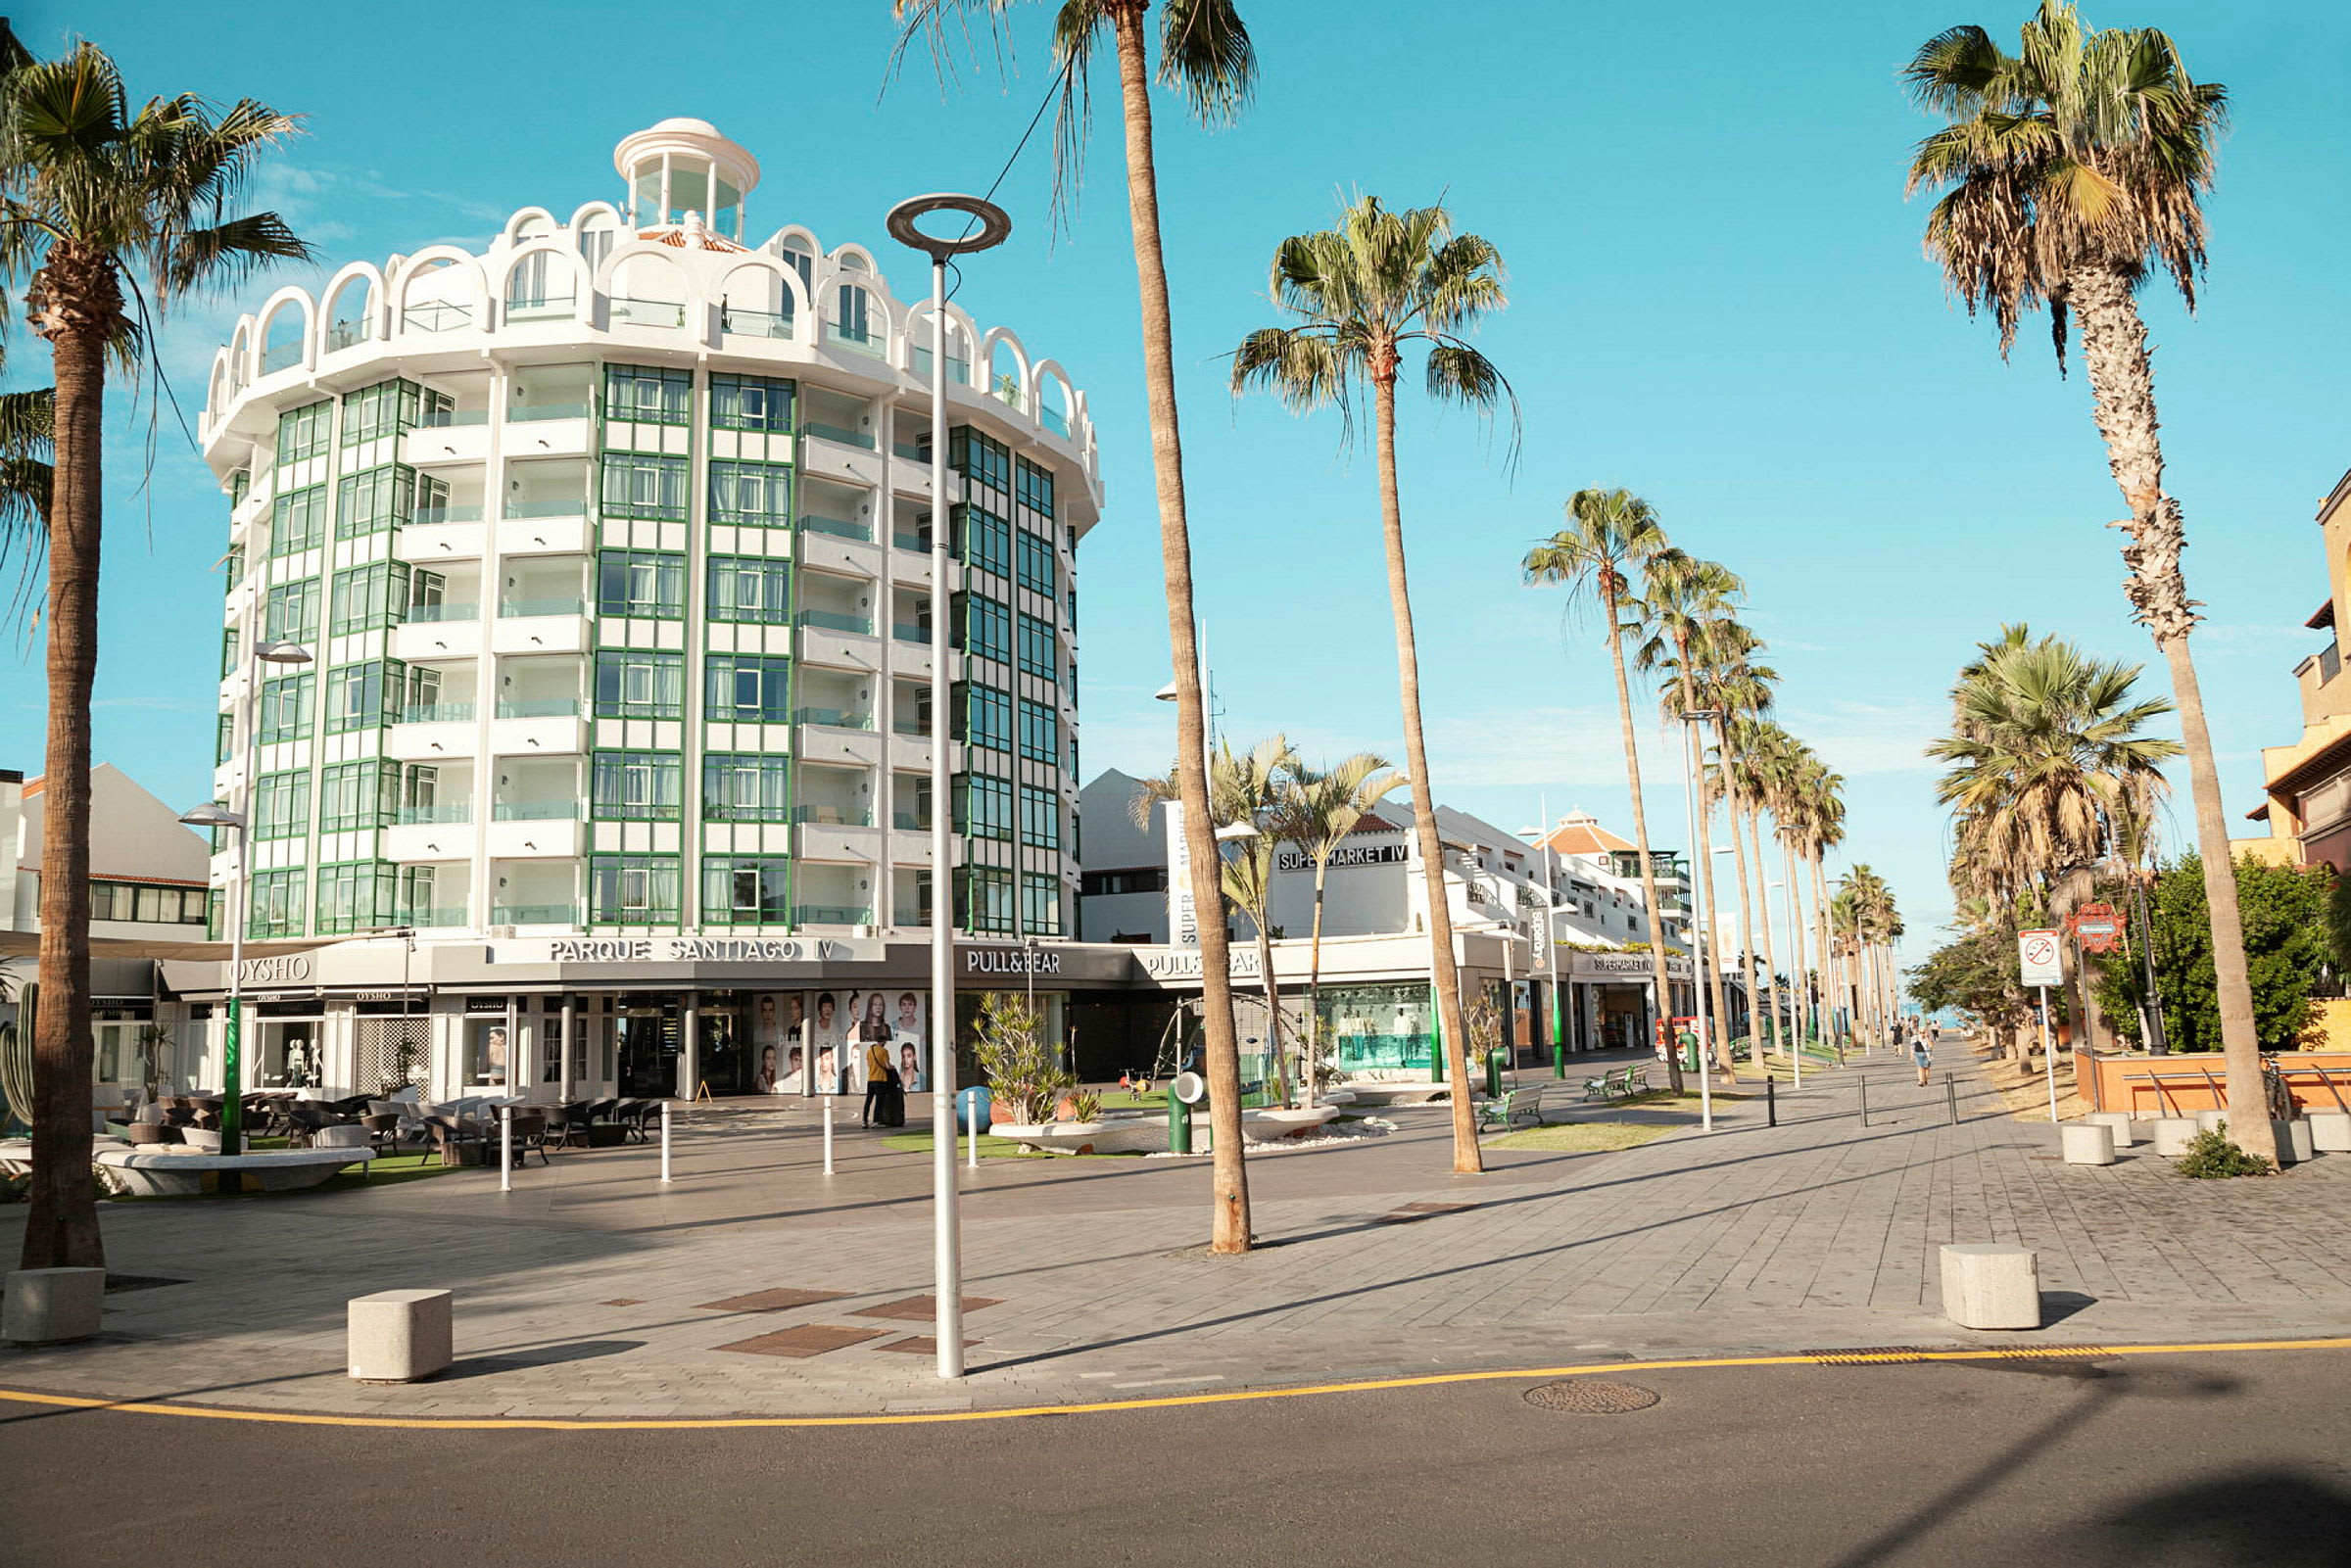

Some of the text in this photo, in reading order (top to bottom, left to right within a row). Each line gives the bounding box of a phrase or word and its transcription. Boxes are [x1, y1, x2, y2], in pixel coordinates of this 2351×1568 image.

[1280, 844, 1405, 870] SUPEMARKET IV
[1181, 893, 1197, 943] SUPER
[550, 939, 834, 961] PARQUE SANTIAGO IV
[966, 950, 1061, 974] PULL&BEAR
[228, 956, 311, 981] OYSHO
[1148, 952, 1260, 975] PULL&AR
[356, 991, 392, 1000] OYSHO
